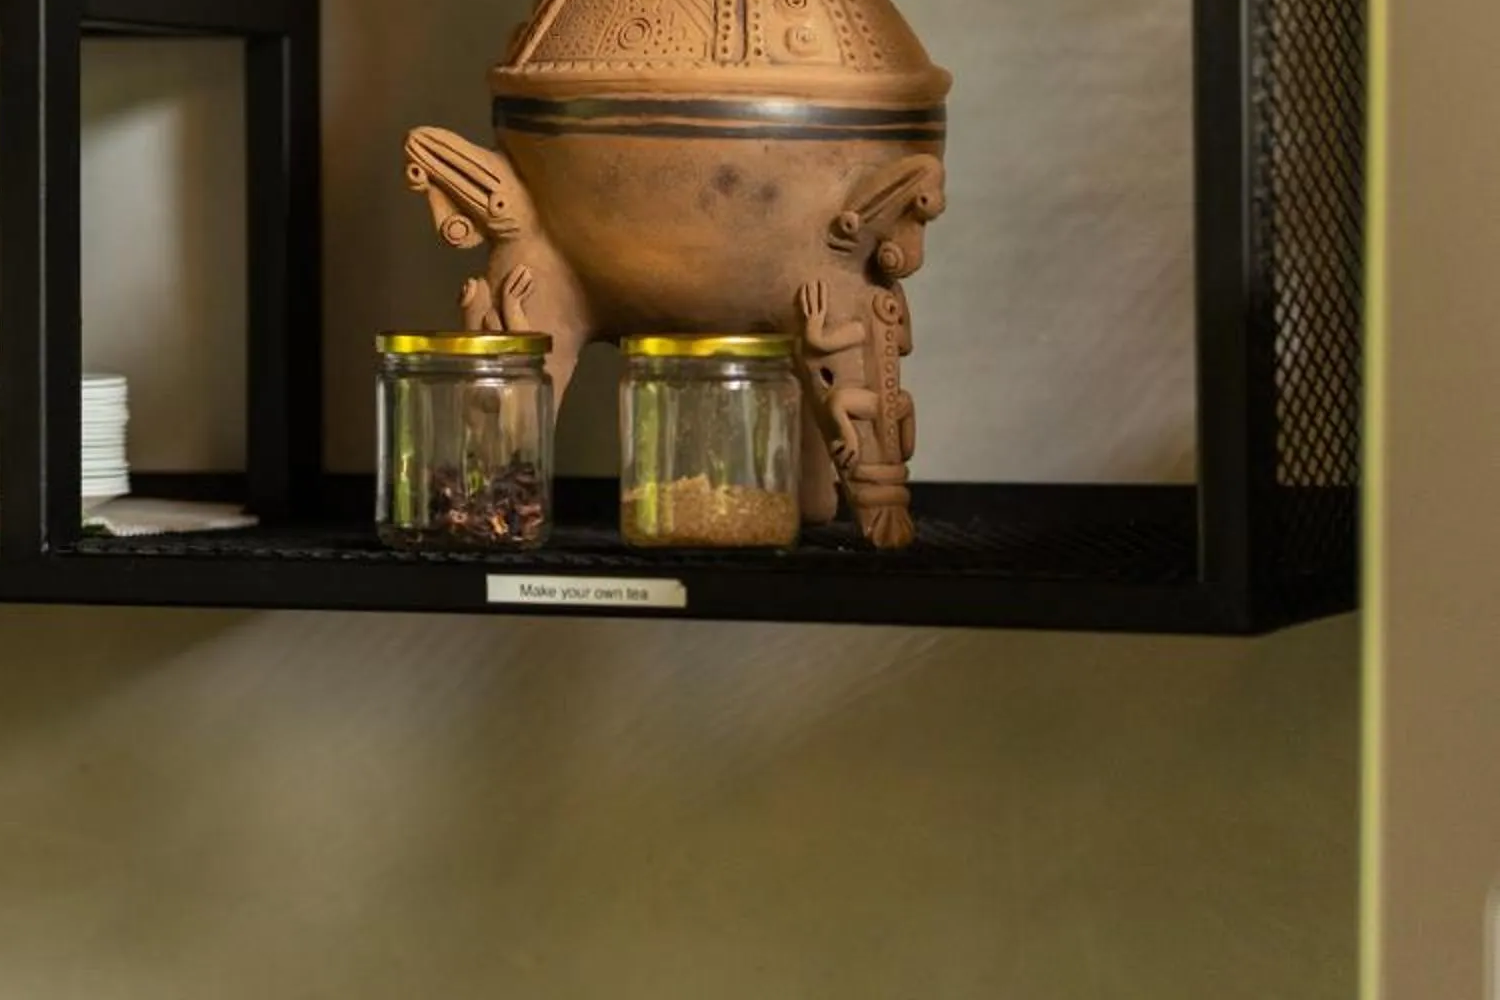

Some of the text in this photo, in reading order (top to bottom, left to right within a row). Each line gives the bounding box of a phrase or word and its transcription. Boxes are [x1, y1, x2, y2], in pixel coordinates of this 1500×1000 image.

[519, 583, 648, 601] Make your own tea
